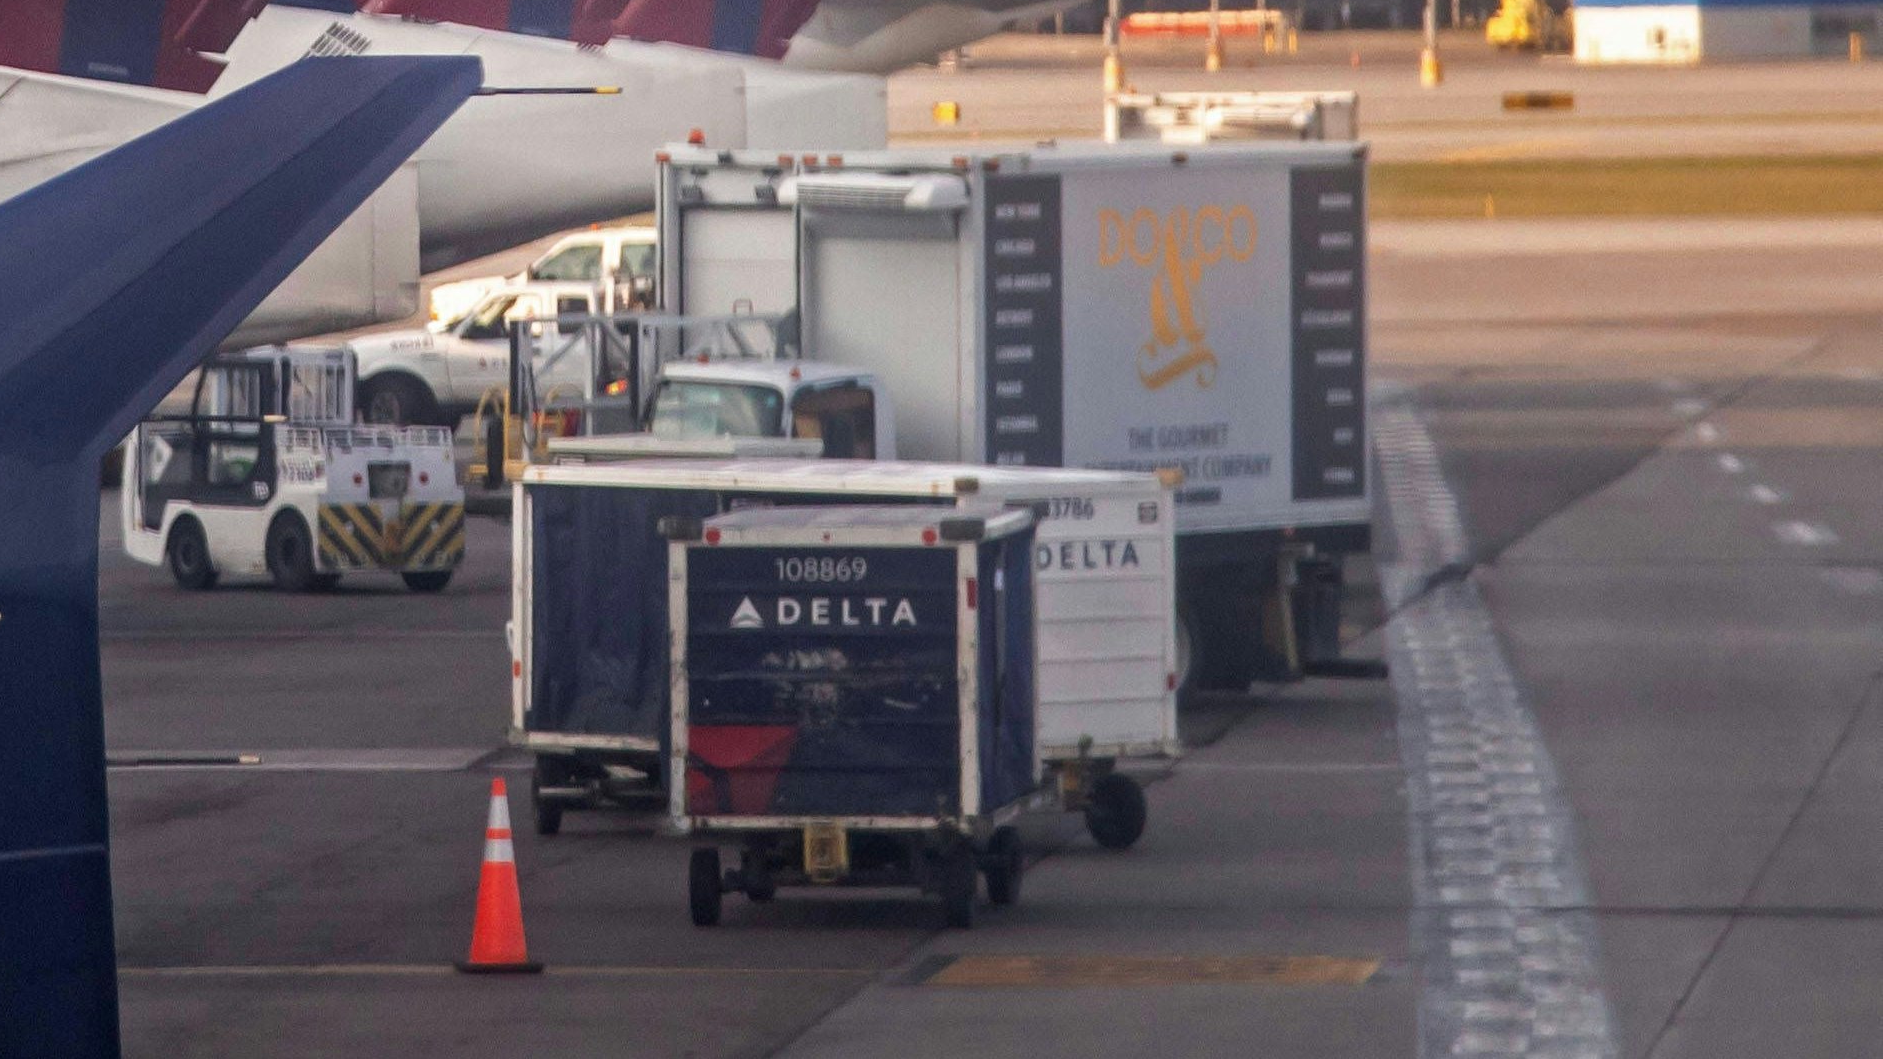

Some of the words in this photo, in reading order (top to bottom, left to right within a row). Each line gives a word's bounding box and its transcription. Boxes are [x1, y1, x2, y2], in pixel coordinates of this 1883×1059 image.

[776, 557, 867, 582] 108869
[1036, 539, 1139, 570] DELTA
[777, 597, 917, 627] DELTA
